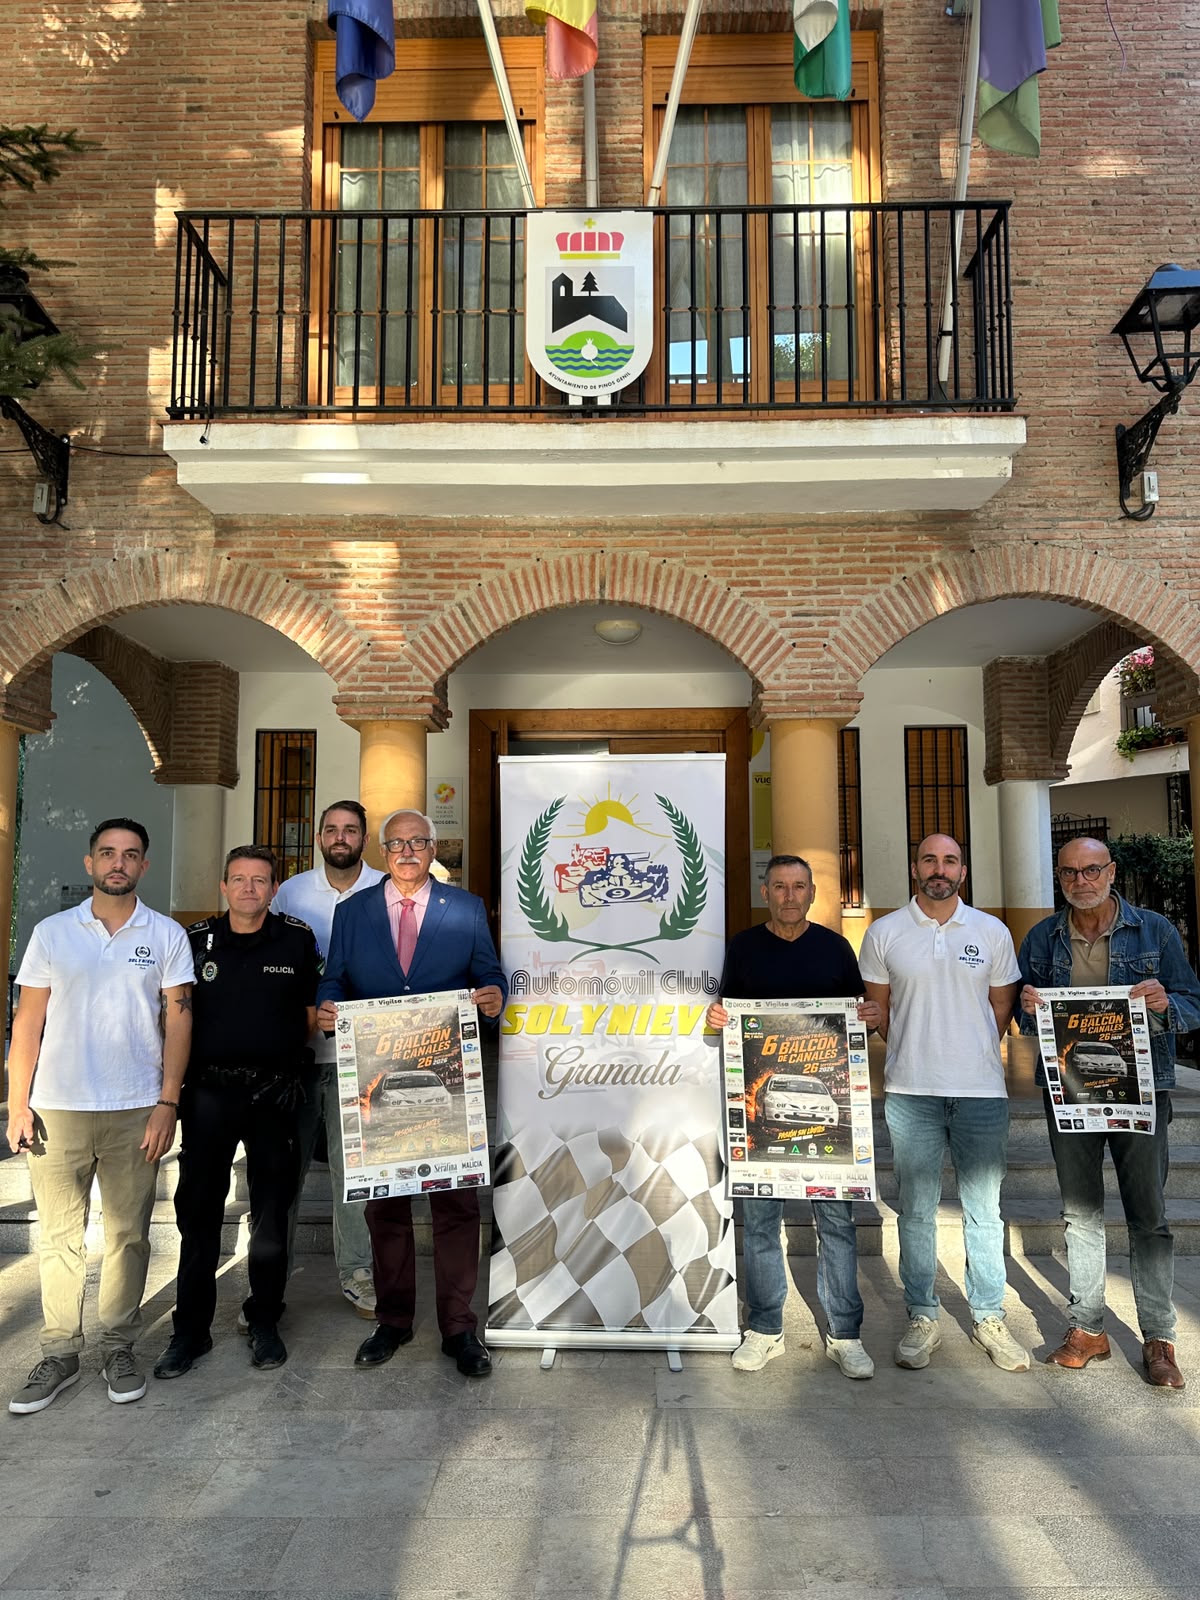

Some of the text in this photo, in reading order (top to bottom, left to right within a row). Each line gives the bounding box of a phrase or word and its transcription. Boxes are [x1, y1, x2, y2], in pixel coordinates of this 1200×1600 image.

[548, 371, 588, 390] AYUNTAMIENTO
[598, 381, 616, 389] PINOS
[616, 372, 631, 382] GENIL
[263, 966, 295, 975] POLICIA
[510, 969, 720, 995] Automóvil Club
[378, 998, 402, 1007] Vigilsa
[501, 1004, 720, 1036] SOL Y NIEV
[1068, 1014, 1080, 1029] 6
[1088, 1023, 1124, 1034] CANALES
[375, 1033, 392, 1056] 6
[1099, 1033, 1111, 1041] 26
[391, 1052, 402, 1060] DE
[403, 1040, 452, 1060] CANALES
[761, 1034, 779, 1056] 6
[417, 1055, 433, 1069] 26
[777, 1048, 838, 1064] DE CANALES
[538, 1046, 683, 1099] Granada
[802, 1062, 820, 1074] 26
[434, 1163, 457, 1173] Serafina
[461, 1160, 482, 1169] MALICIA
